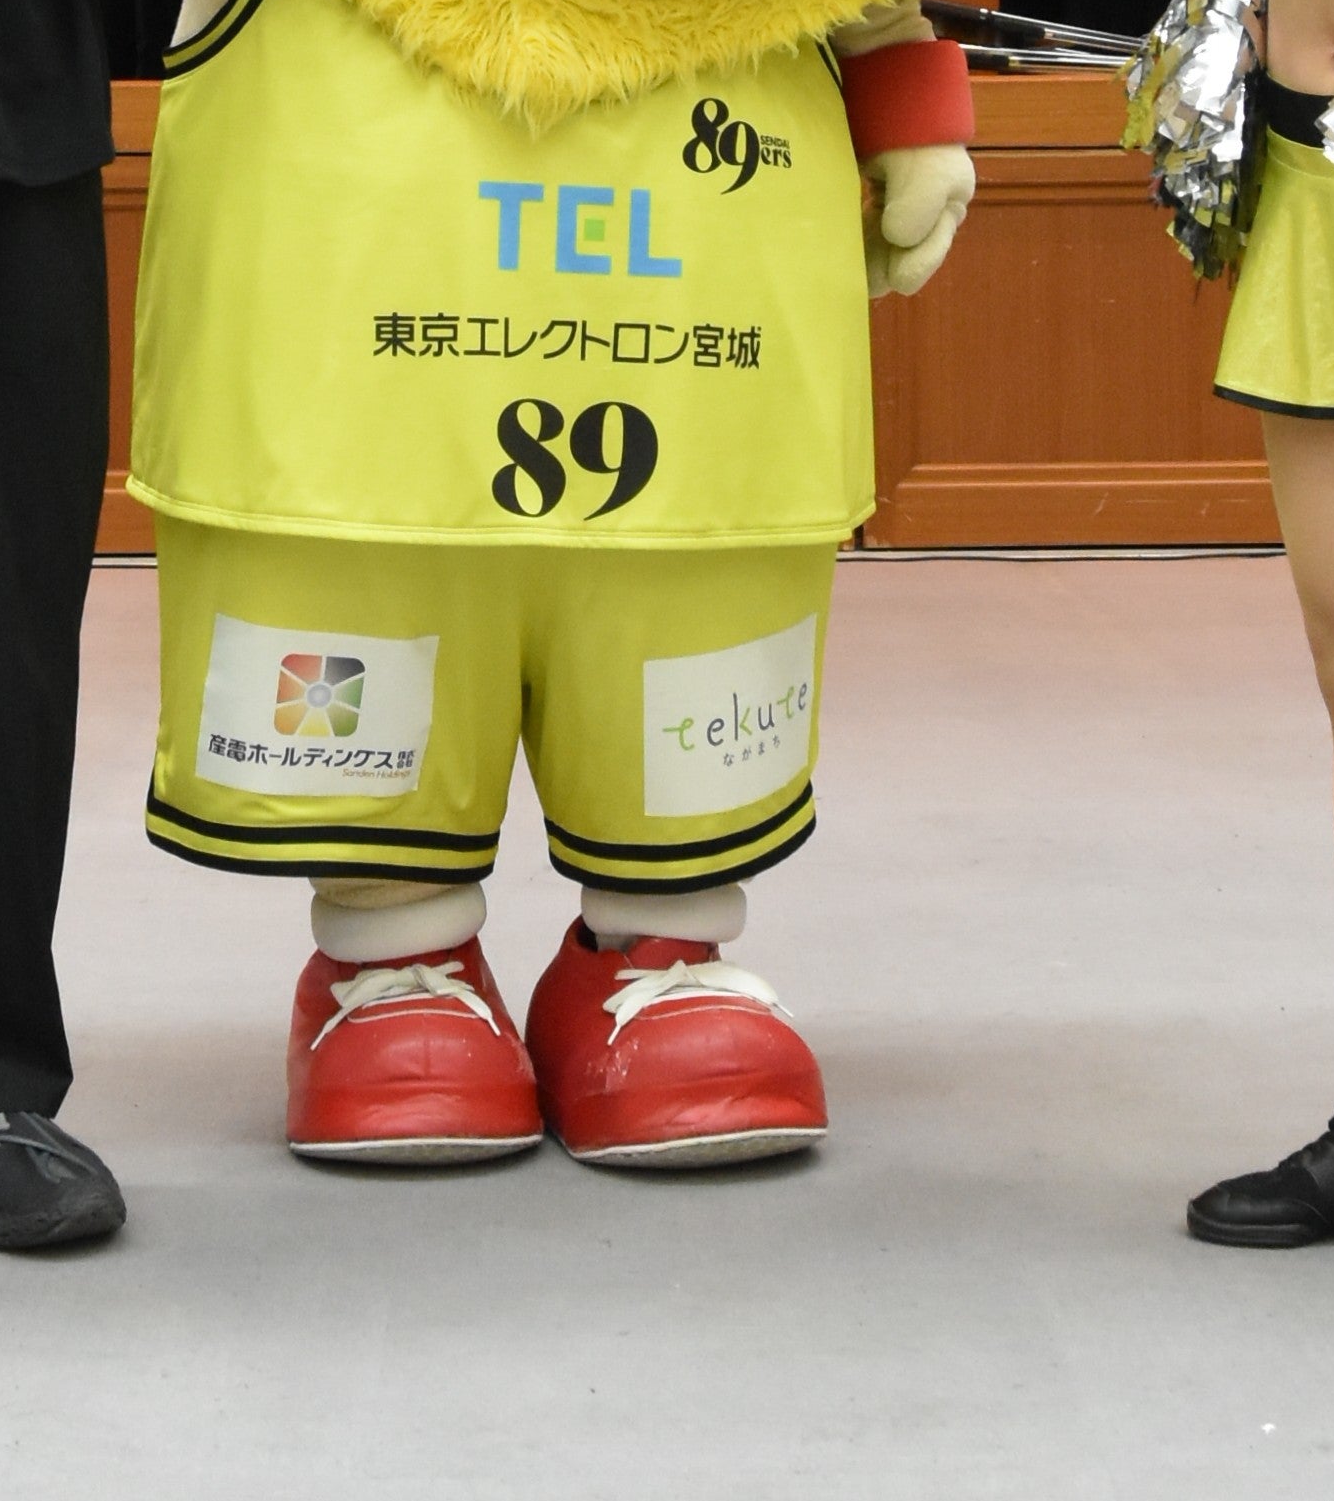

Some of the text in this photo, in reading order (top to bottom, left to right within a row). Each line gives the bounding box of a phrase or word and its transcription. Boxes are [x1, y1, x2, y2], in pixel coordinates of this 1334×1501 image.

[478, 180, 683, 278] TEL
[373, 312, 762, 369] 東京エレクトロン宮城
[491, 397, 660, 522] 89
